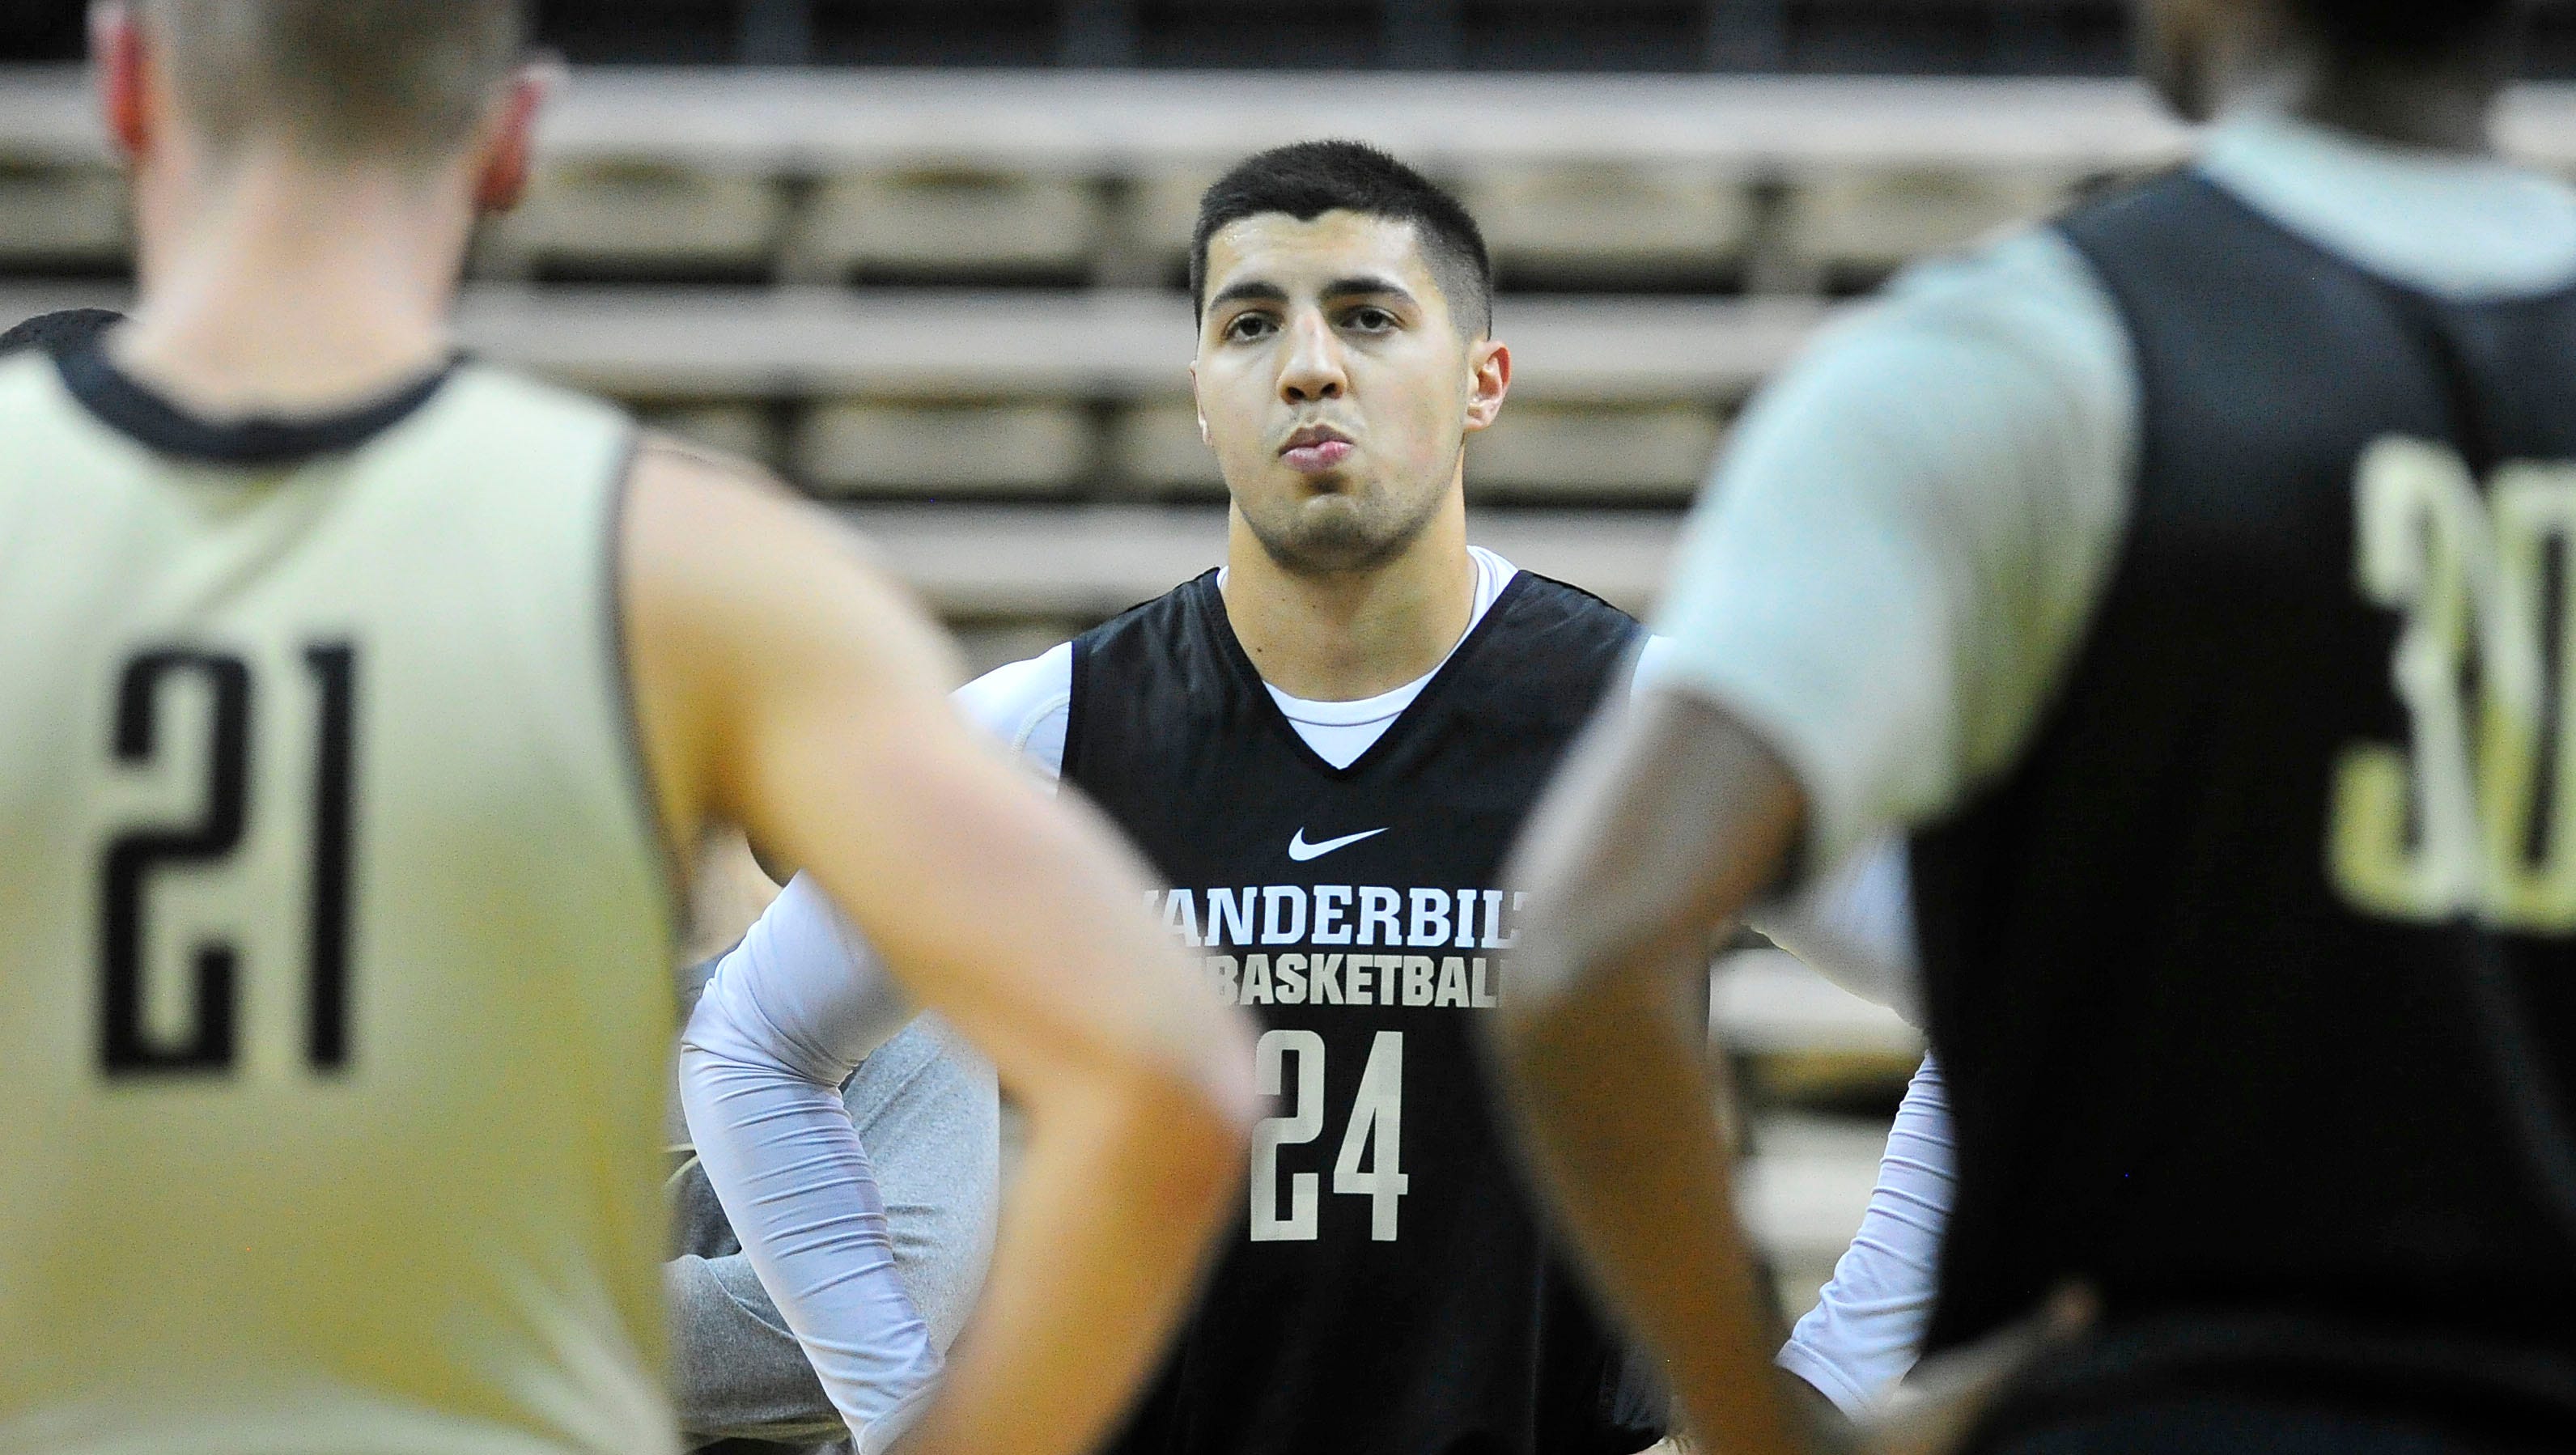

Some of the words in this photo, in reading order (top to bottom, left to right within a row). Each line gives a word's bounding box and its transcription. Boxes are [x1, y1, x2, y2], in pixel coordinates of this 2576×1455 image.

[2332, 435, 2576, 934] 30
[99, 635, 359, 1076] 21
[1143, 885, 1528, 948] ANDERBIL
[1206, 953, 1505, 1008] BASKETBAL
[1250, 1029, 1408, 1241] 24
